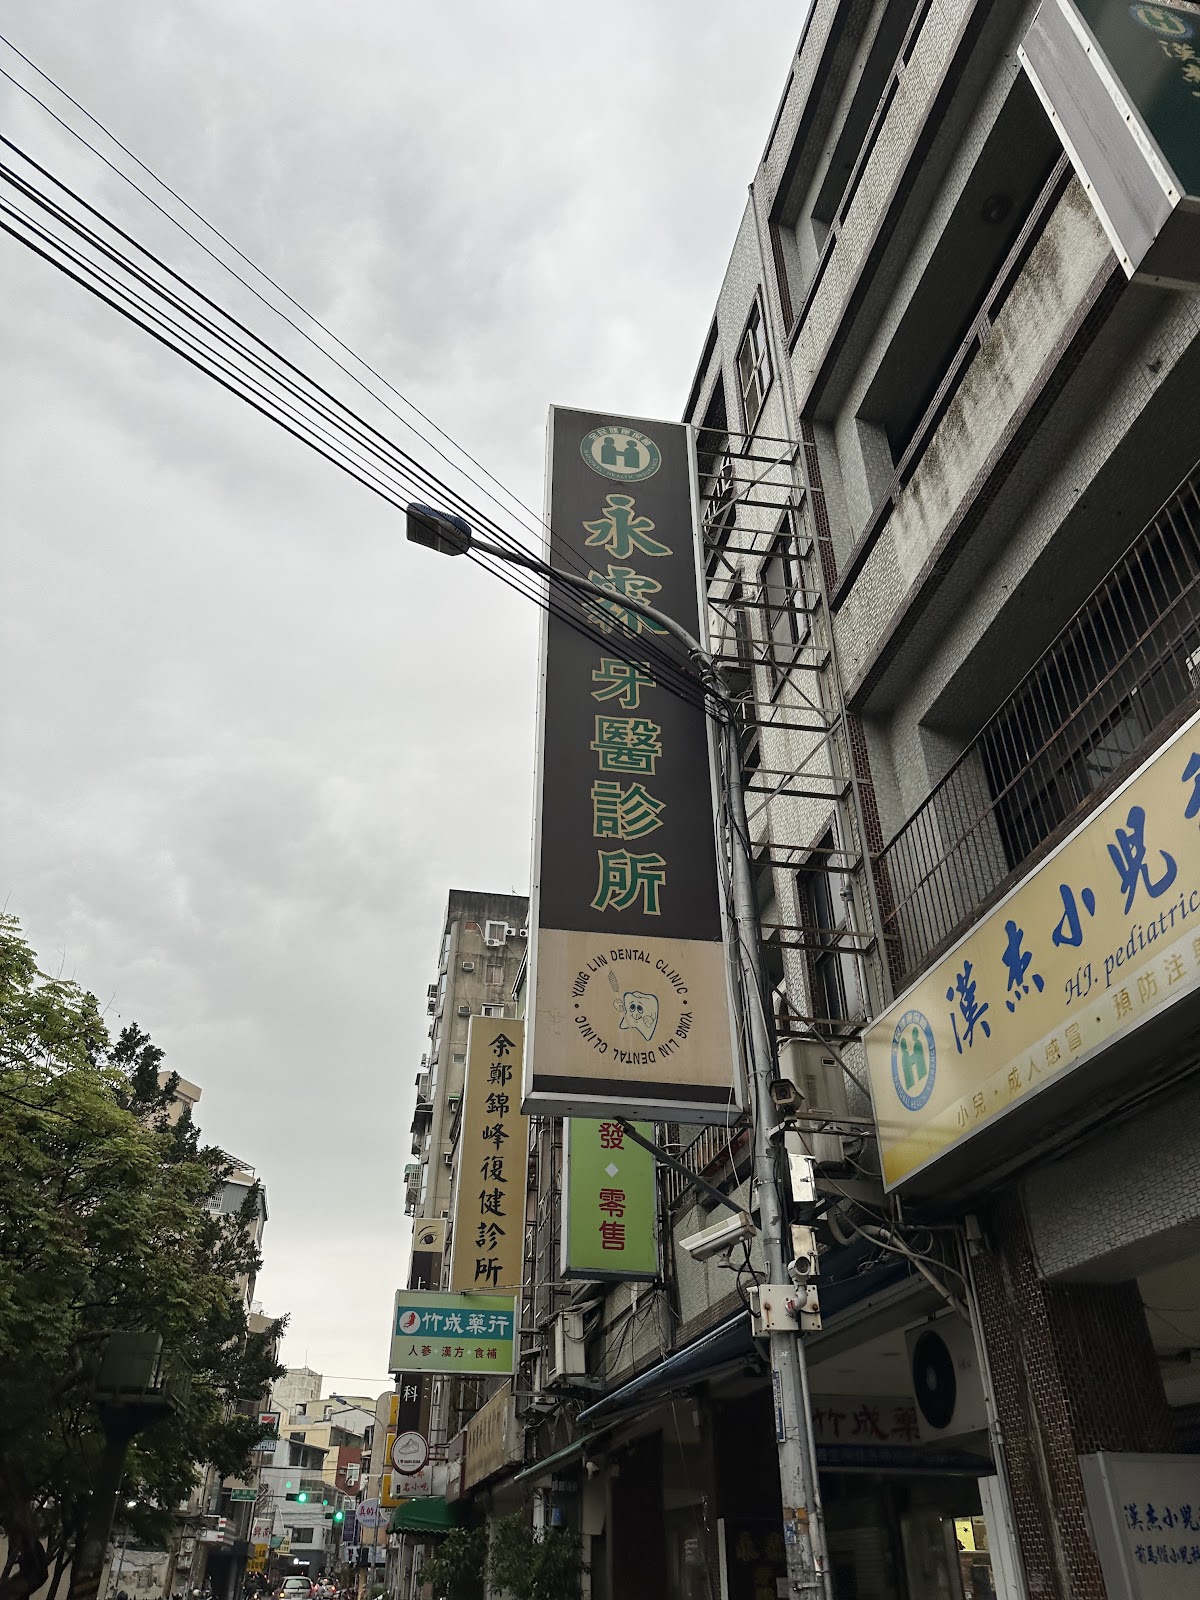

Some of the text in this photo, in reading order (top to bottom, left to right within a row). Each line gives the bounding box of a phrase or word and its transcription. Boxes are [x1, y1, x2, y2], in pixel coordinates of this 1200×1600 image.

[946, 752, 1200, 1054] 漢杰小兒
[1103, 890, 1200, 989] pediatric
[572, 949, 688, 998] YUNG LIN DENTAL CLINIC
[574, 1011, 693, 1065] YUNG LIN DENTAL CLINIC
[474, 1033, 516, 1287] 余鄭錦峰復健診所
[598, 1188, 626, 1250] 零售
[422, 1312, 510, 1336] 竹成藥行
[441, 1346, 465, 1358] 漢方
[474, 1347, 498, 1359] 食補
[403, 1385, 418, 1402] 科
[1123, 1502, 1200, 1532] 漢杰小兒
